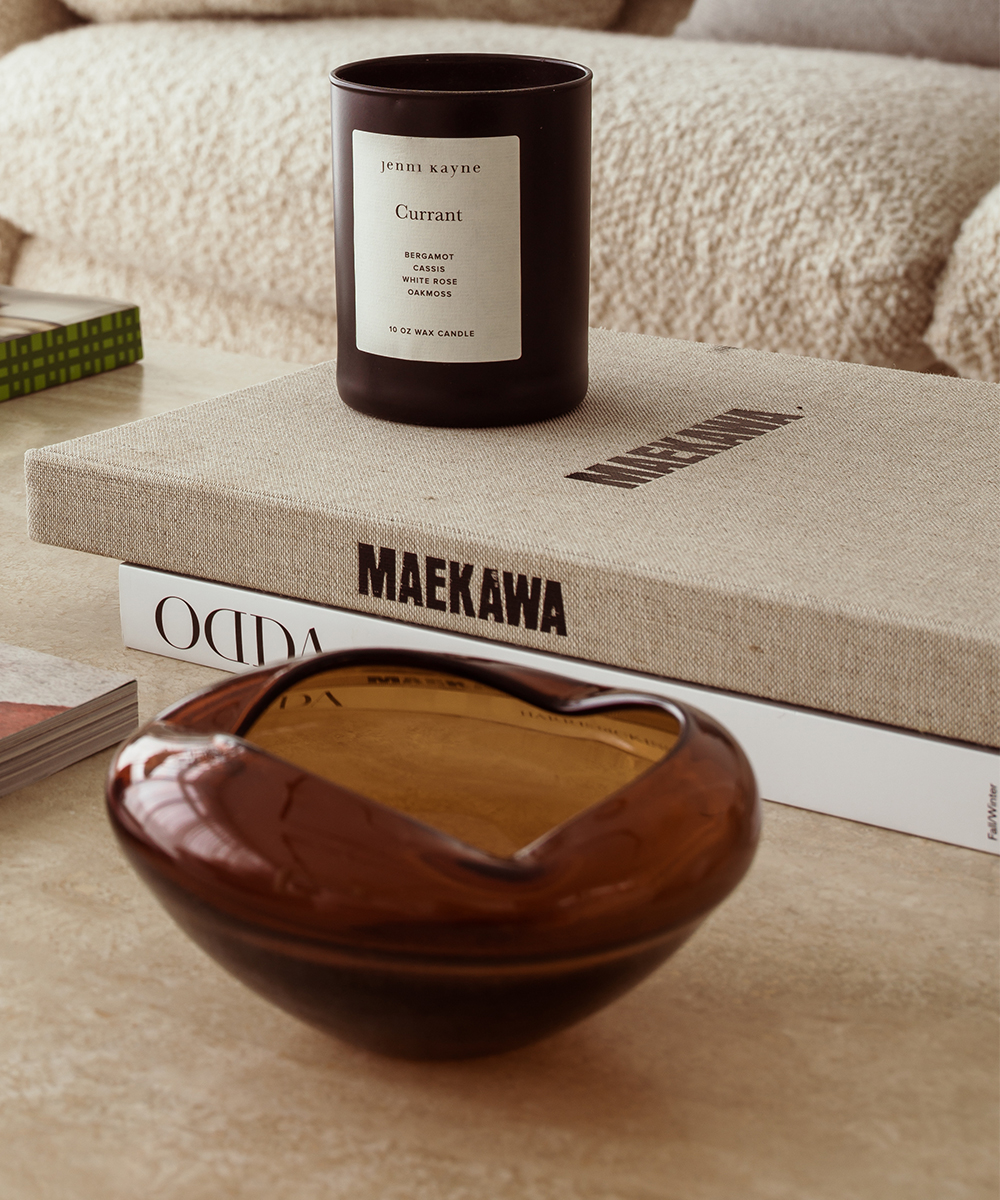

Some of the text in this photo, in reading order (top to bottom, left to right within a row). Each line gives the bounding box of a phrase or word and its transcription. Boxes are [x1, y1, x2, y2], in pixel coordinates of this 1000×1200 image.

[395, 203, 463, 223] Currant
[404, 251, 455, 261] BERGAMOT
[412, 263, 446, 273] CASSIS
[401, 275, 458, 286] WHITE ROSE
[407, 288, 453, 298] OAKMOSS
[388, 325, 476, 338] 10 OZ WAX CANDLE
[563, 408, 805, 489] MAEKAWA
[358, 542, 568, 637] MAEKAWA
[987, 782, 998, 841] Fall/Winter
